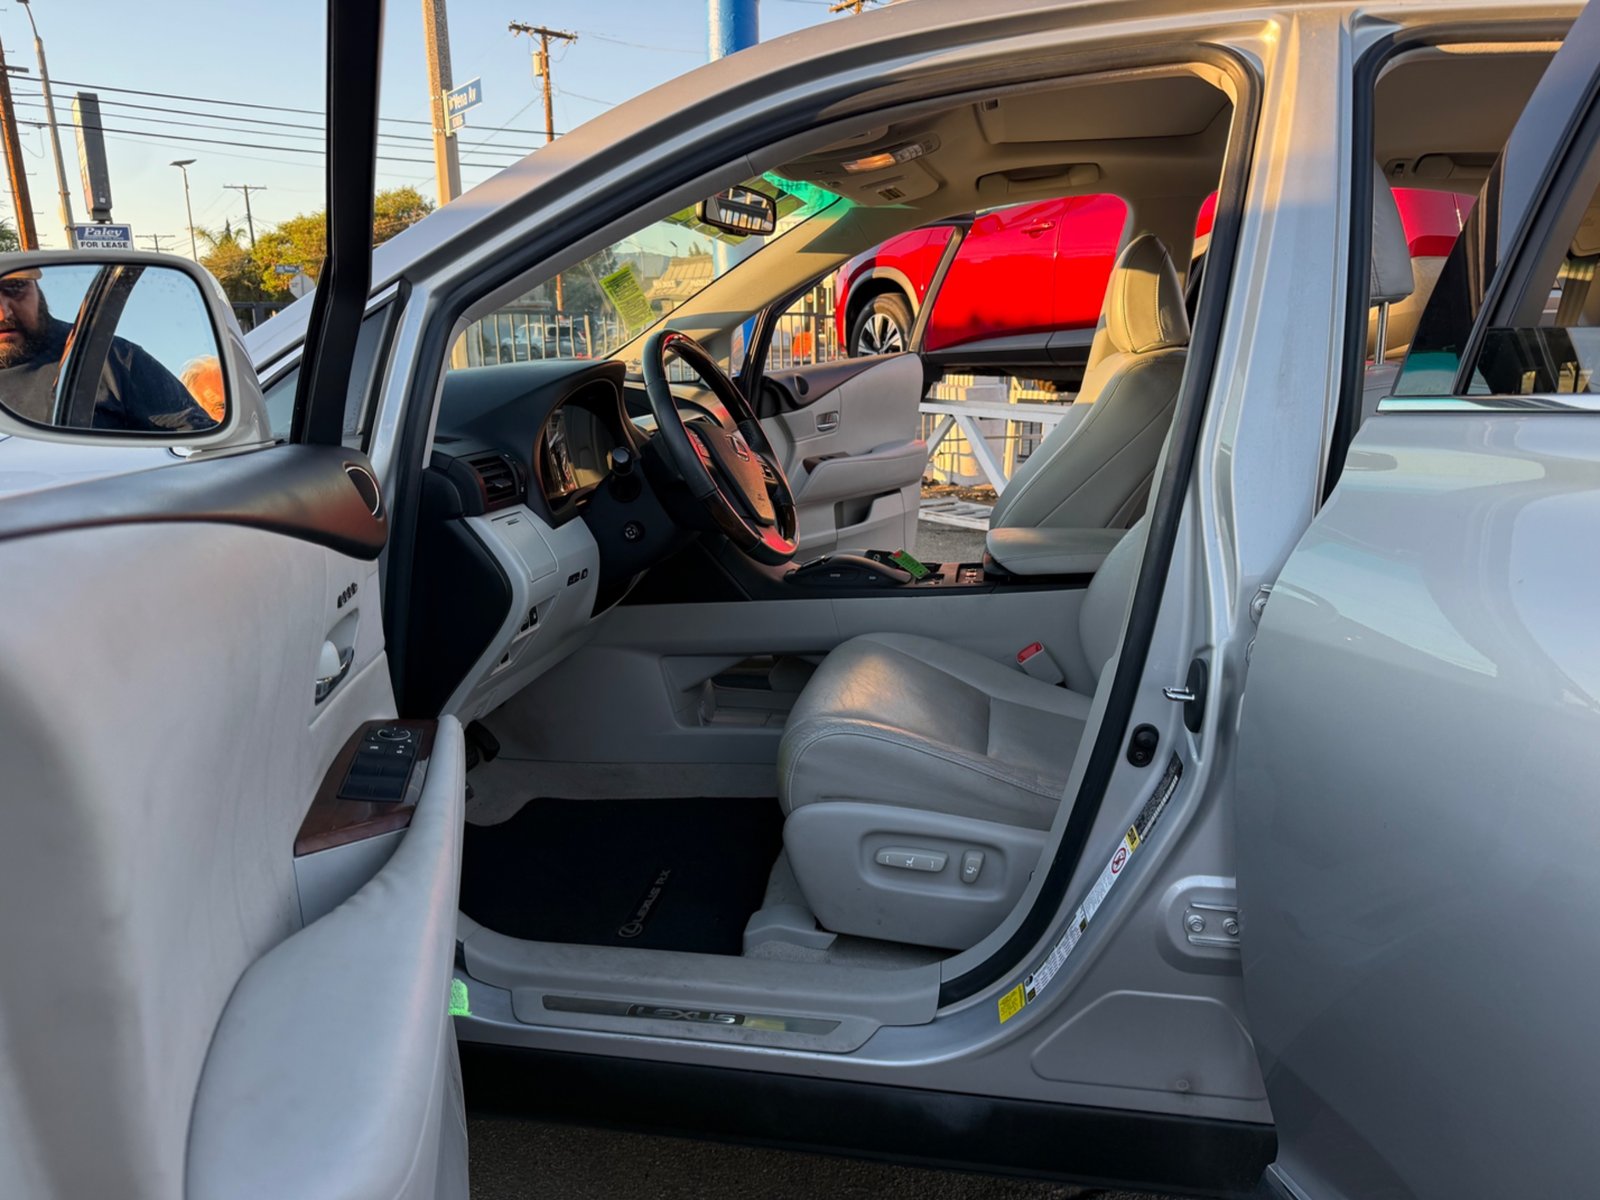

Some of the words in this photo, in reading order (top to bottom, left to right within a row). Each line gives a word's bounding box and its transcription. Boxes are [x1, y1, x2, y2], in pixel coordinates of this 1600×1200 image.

[84, 227, 123, 237] Paley
[632, 886, 661, 923] LEXUS
[636, 1005, 736, 1024] LEXUS
